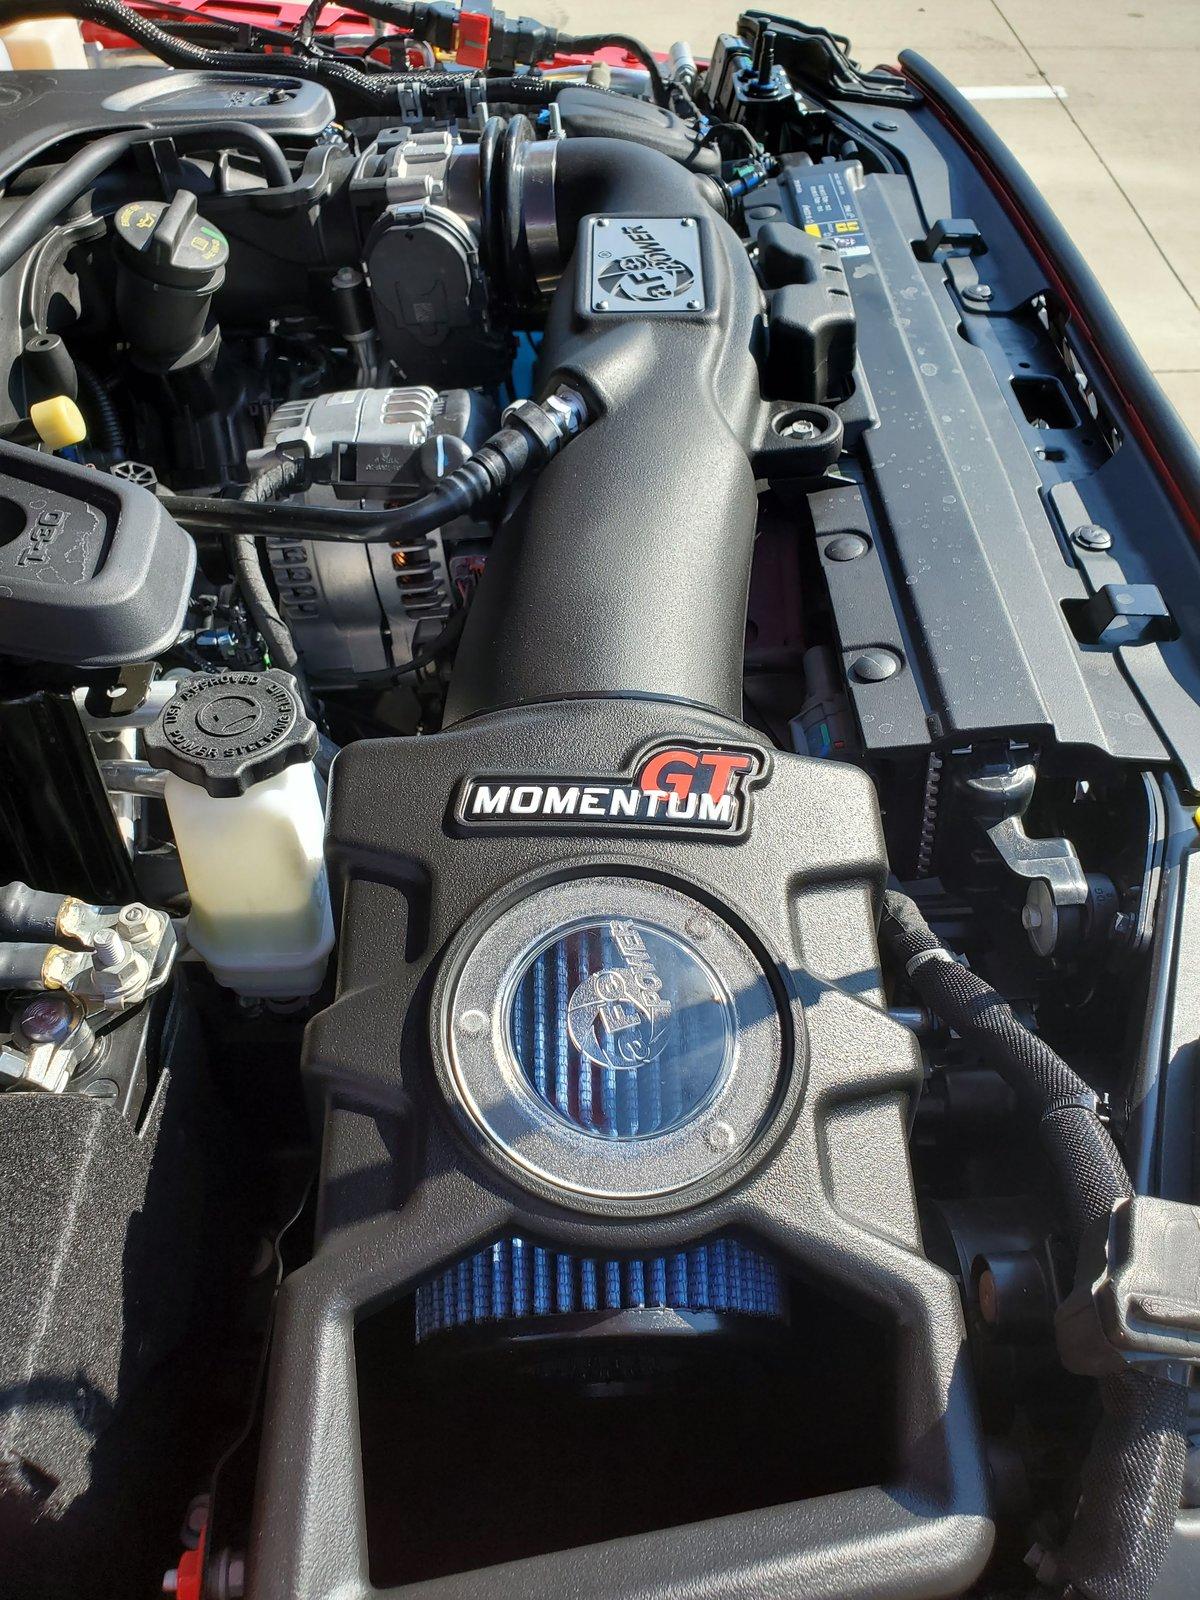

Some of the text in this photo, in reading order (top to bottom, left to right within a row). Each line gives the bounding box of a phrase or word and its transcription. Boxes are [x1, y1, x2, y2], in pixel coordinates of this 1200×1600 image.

[620, 225, 684, 271] POWER
[180, 676, 261, 701] APPROVED
[170, 729, 219, 759] POWER
[223, 715, 292, 758] STEERING
[640, 749, 752, 803] GT
[471, 785, 737, 823] MOMENTUM
